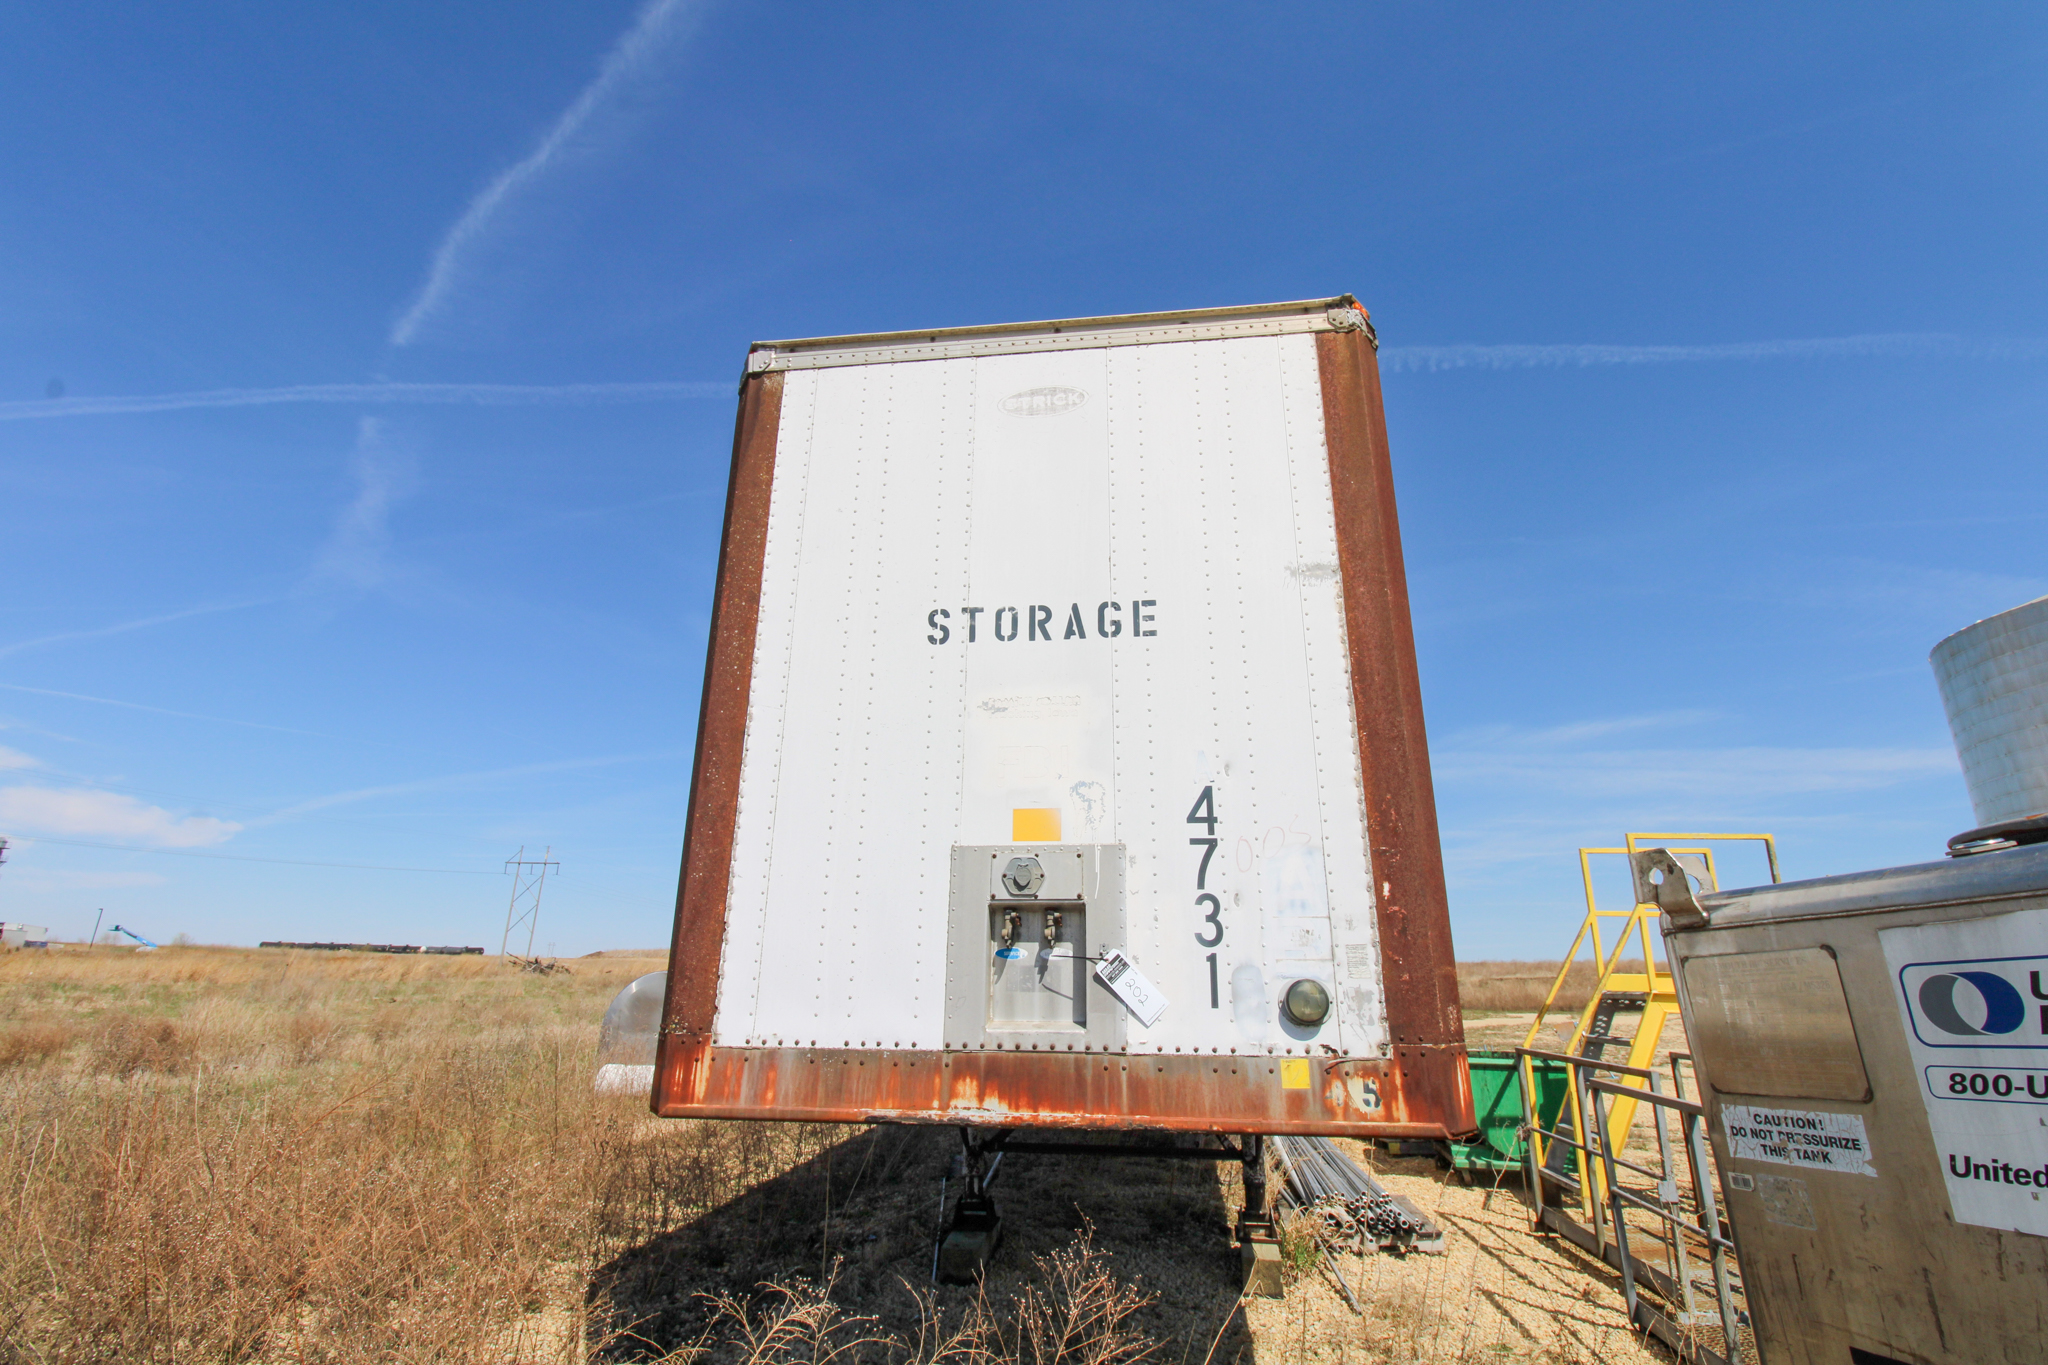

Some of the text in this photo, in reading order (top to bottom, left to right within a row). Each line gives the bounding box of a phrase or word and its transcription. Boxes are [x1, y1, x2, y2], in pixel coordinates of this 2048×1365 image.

[1003, 391, 1082, 410] STRICK
[927, 599, 1158, 645] STORAGE
[1186, 785, 1224, 1009] 4731
[1125, 978, 1149, 1007] 202
[1949, 1072, 2048, 1099] 800-U
[1730, 1125, 1748, 1137] DO
[1750, 1128, 1774, 1141] NOT
[1793, 1148, 1833, 1165] TANK
[1949, 1153, 2048, 1188] United
